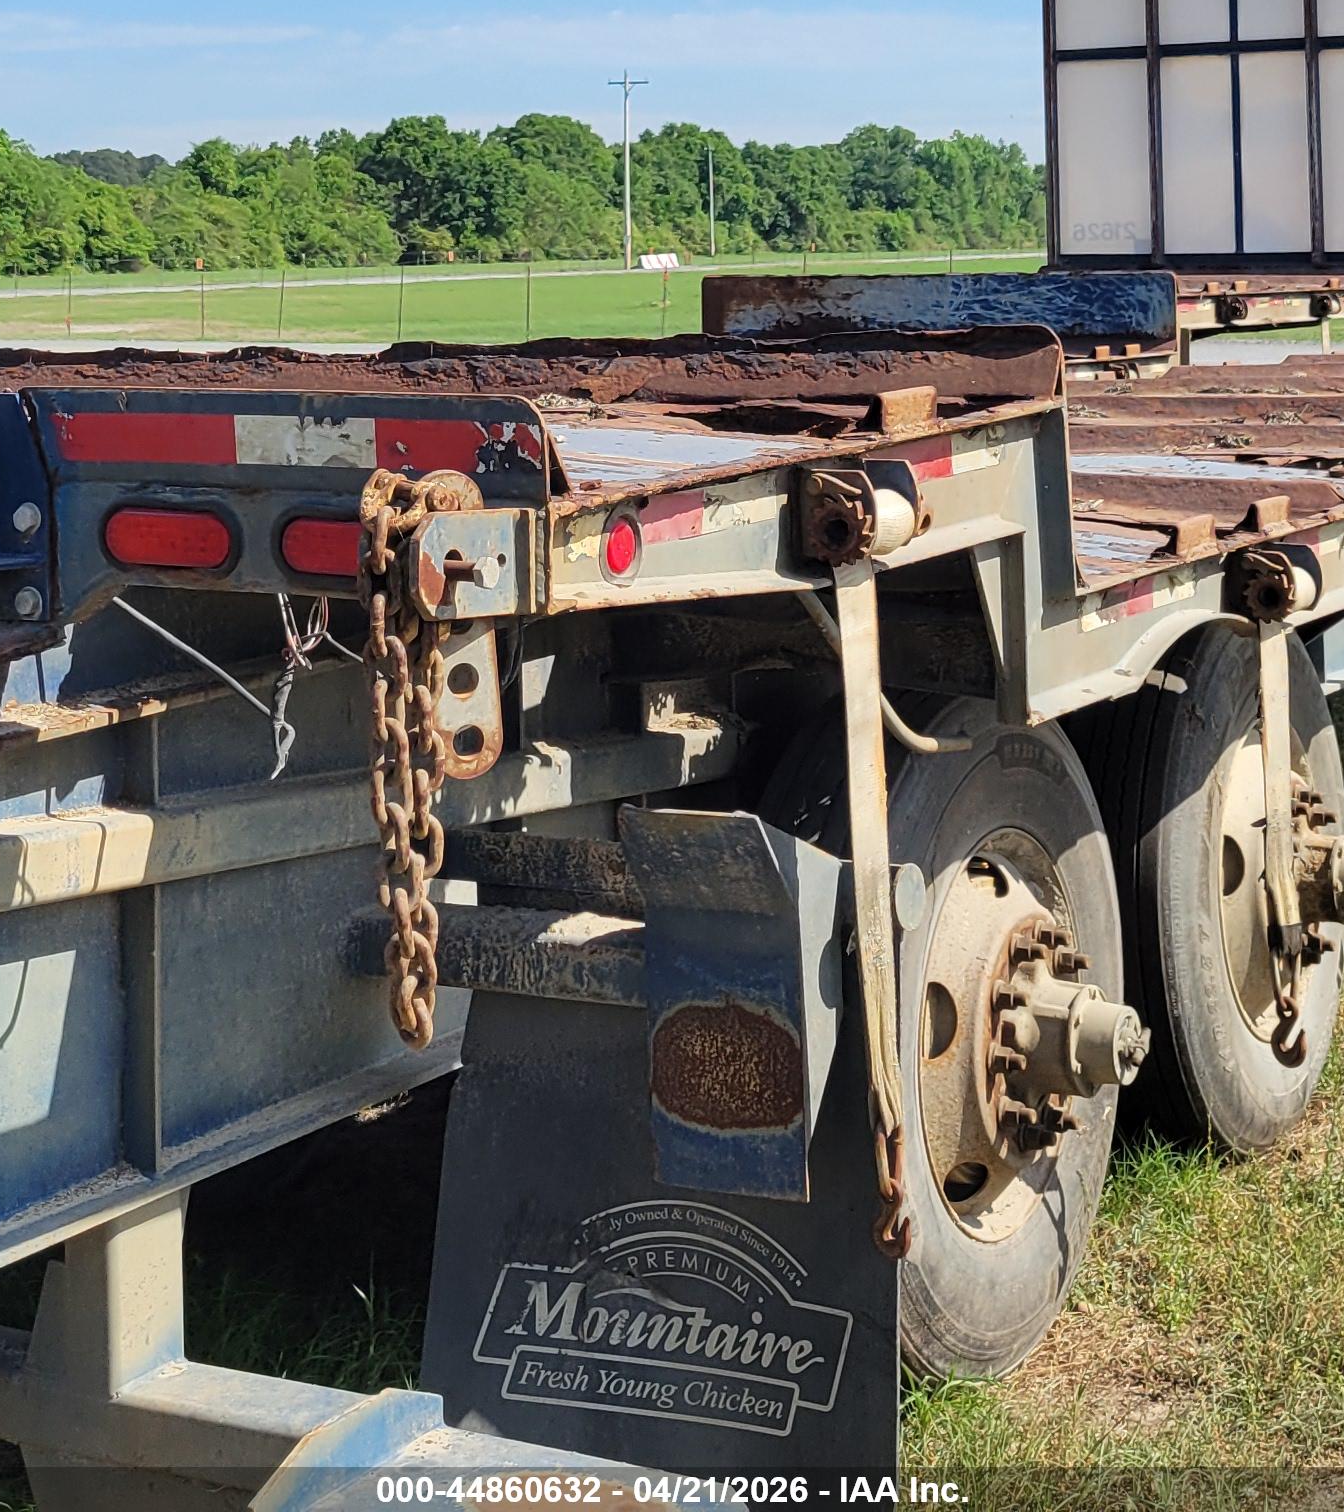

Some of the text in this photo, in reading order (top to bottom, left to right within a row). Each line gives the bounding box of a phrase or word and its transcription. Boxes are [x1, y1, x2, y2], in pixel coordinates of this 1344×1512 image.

[625, 1207, 669, 1226] Owned
[671, 1207, 683, 1221] &
[685, 1209, 739, 1237] Operated
[739, 1229, 770, 1257] Since
[627, 1249, 751, 1297] PREMIUM
[504, 1279, 824, 1374] Mountaire
[518, 1360, 784, 1419] Fresh Young Chicken
